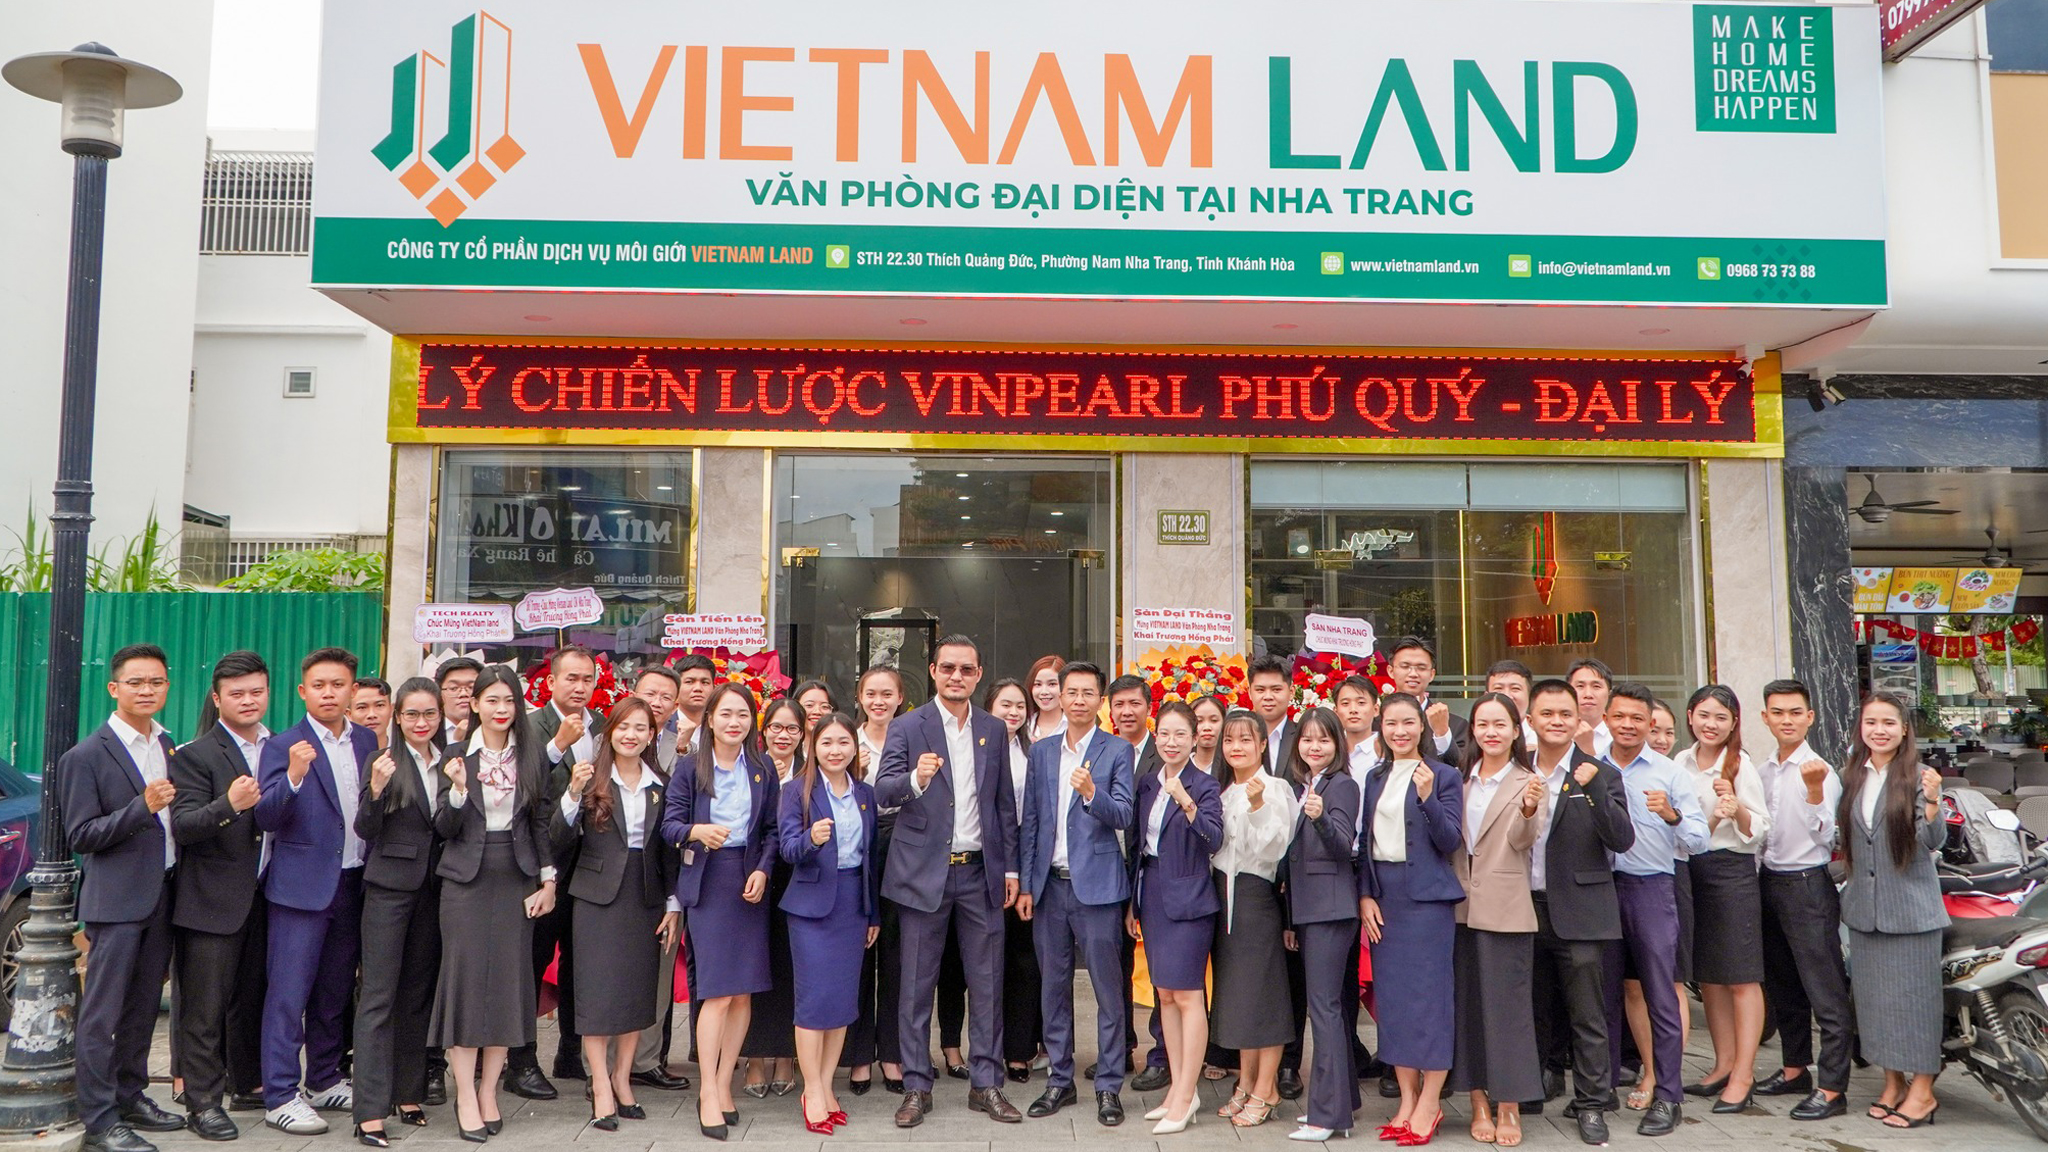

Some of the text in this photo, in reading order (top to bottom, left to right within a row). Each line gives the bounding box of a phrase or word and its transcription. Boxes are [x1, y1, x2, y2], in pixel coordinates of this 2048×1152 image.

[1712, 15, 1814, 40] MAKE
[1888, 0, 1930, 30] 0799
[1712, 43, 1815, 67] HOME
[1713, 69, 1816, 94] DREAMS
[577, 43, 1639, 174] VIETNAM LAND
[1714, 96, 1817, 121] HAPPEN
[745, 171, 1474, 222] VĂN PHÒNG ĐẠI DIỆN TẠI NHA TRANG
[387, 235, 813, 265] CÔNG TY CỔ PHẦN DỊCH VỤ MÔI GIỚI VIETNAM LAND
[857, 251, 883, 266] STH
[886, 252, 923, 267] 22.30
[926, 252, 961, 267] Thích
[965, 252, 1005, 270] Quảng
[1008, 253, 1037, 270] Đức,
[1041, 254, 1088, 271] Phường
[1092, 255, 1121, 269] Nam
[1125, 255, 1150, 269] Nha
[1153, 256, 1193, 272] Trang,
[1227, 257, 1266, 271] Khánh
[1270, 257, 1295, 272] Hòa
[1350, 259, 1480, 274] www.vietnamland.vn
[1537, 261, 1671, 277] info@vietnamland.vn
[1726, 263, 1816, 279] 0968 73 73 88
[416, 354, 497, 410] LÝ
[511, 355, 702, 414] CHIẾN
[714, 363, 886, 426] LƯỢC
[900, 371, 1205, 418] VINPEARL
[1218, 365, 1342, 422] PHÚ
[1355, 367, 1486, 433] QUÝ
[1533, 379, 1643, 433] ĐẠI
[1655, 370, 1737, 424] LÝ
[1162, 514, 1206, 533] STH 22.30
[1326, 625, 1342, 634] NHA
[1342, 626, 1368, 638] TRANG
